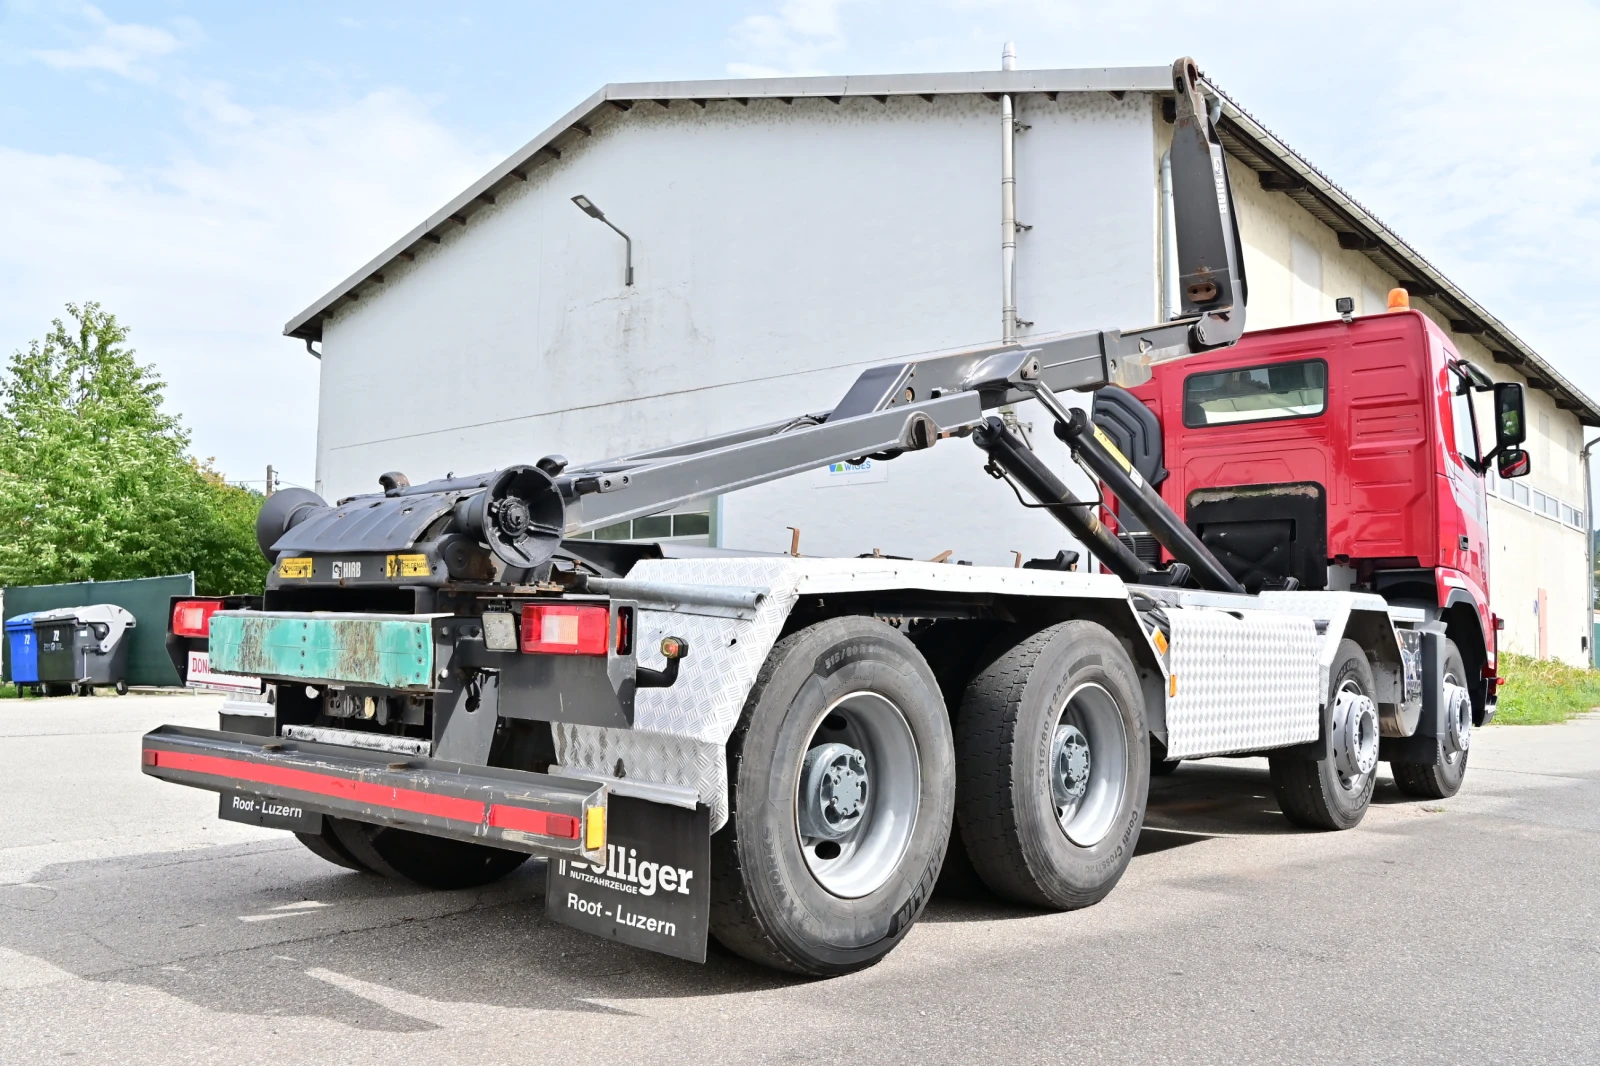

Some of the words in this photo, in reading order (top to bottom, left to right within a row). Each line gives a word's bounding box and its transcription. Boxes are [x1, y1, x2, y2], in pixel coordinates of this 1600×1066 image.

[343, 562, 361, 578] HIAB
[24, 634, 31, 645] 72
[53, 630, 60, 641] 72
[192, 657, 211, 674] DON
[1039, 720, 1050, 777] 315/80
[1047, 705, 1054, 718] R
[1053, 673, 1069, 702] 22.5
[233, 796, 254, 811] Root
[262, 801, 302, 818] Luzern
[1122, 810, 1138, 847] Conti
[570, 870, 638, 895] NUTZFAHRZEUGE
[567, 892, 603, 918] Root
[616, 904, 676, 937] Luzern
